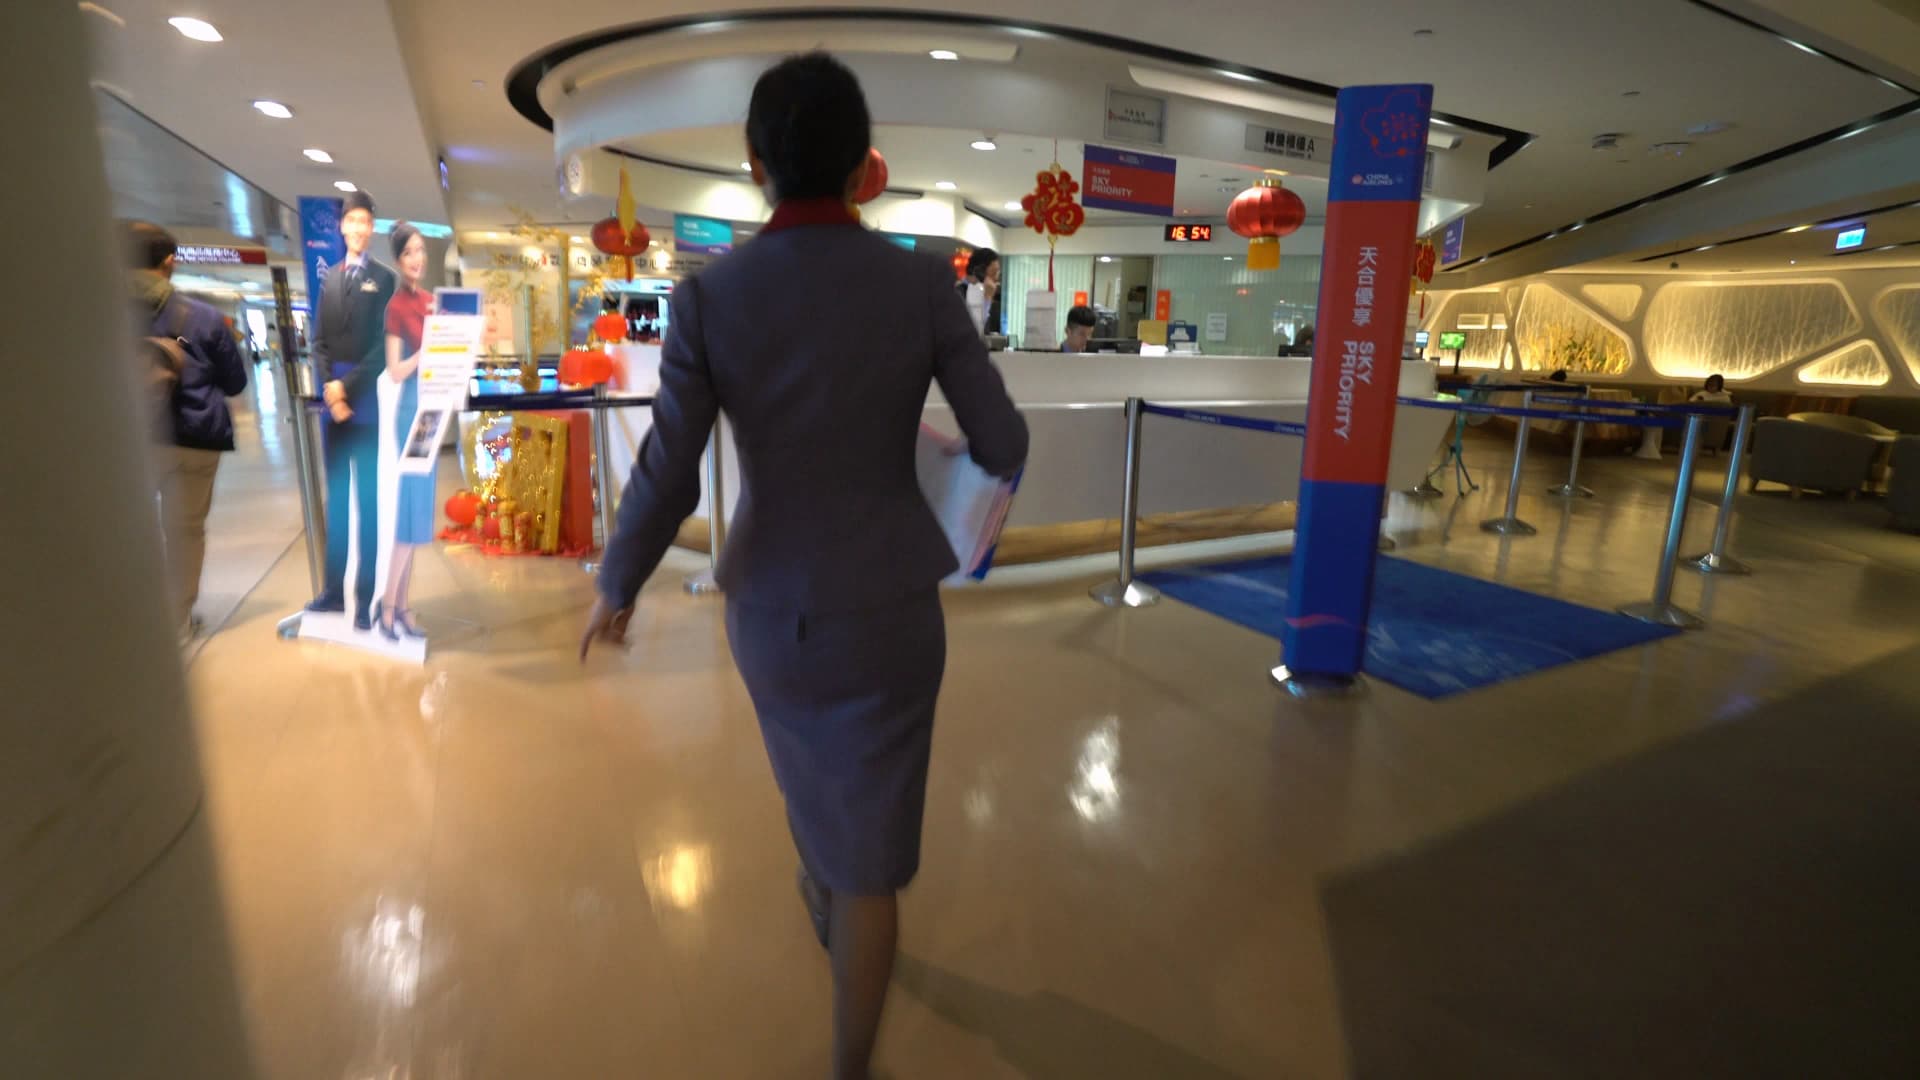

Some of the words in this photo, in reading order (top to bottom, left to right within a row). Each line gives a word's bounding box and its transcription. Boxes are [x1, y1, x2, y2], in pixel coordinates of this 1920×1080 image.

[1091, 175, 1110, 186] SKY
[1091, 183, 1133, 198] PRIORITY
[1171, 226, 1186, 239] 16
[1190, 226, 1210, 240] 54
[1352, 246, 1378, 327] 天合優享
[1356, 341, 1376, 385] SKY
[1333, 340, 1359, 441] PRIORITY
